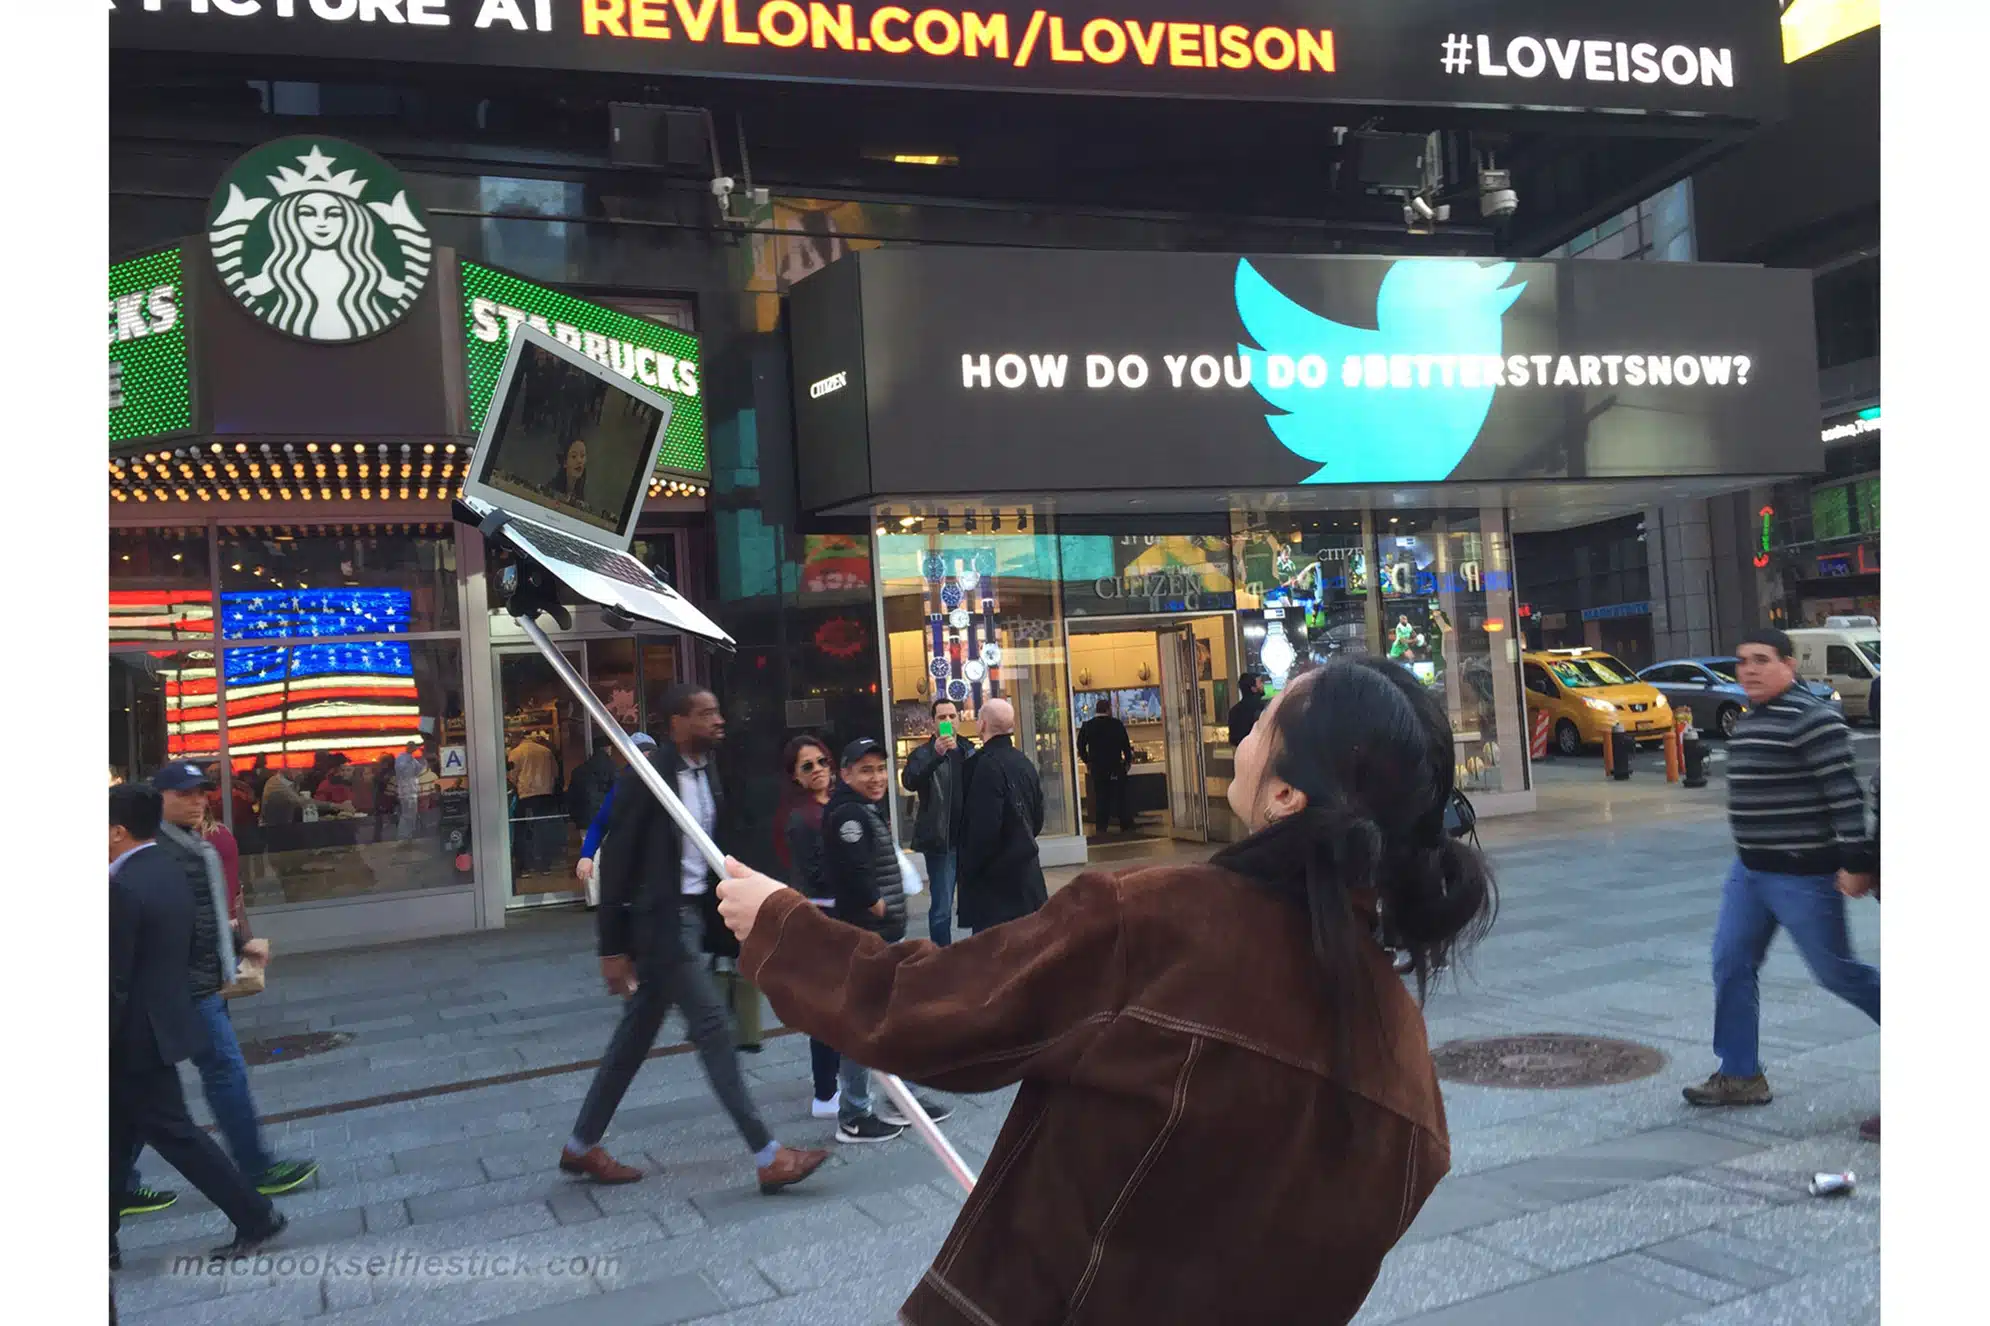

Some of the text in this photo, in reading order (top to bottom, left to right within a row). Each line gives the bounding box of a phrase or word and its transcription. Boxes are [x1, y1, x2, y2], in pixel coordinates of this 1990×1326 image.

[582, 0, 1336, 73] REVLON.COM/LOVEISON
[1440, 33, 1734, 88] #LOVEISON
[109, 284, 178, 346] KS
[961, 353, 1752, 389] HOW DO YOU DO #BETTERSTARTSNOW?
[1094, 573, 1202, 600] CITIZEN
[446, 750, 462, 768] A
